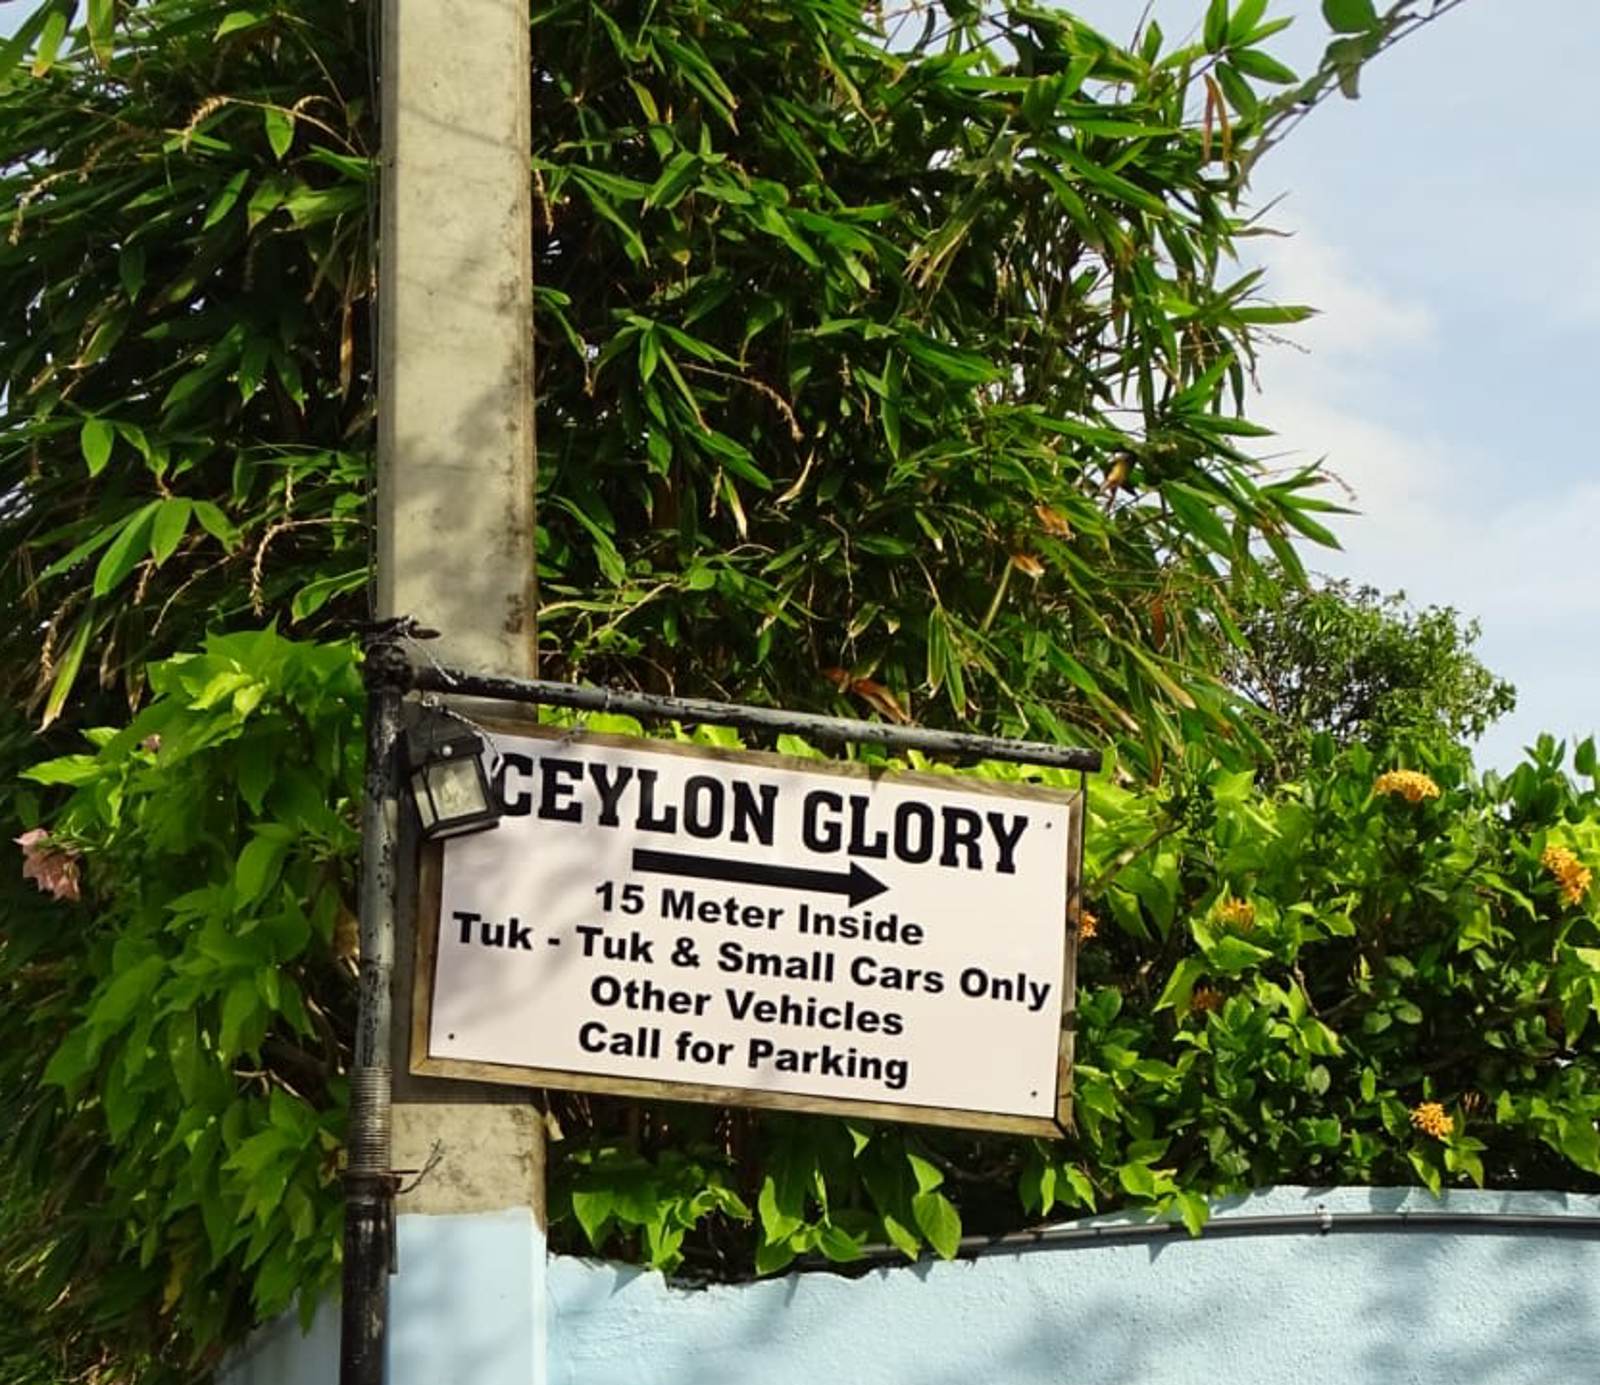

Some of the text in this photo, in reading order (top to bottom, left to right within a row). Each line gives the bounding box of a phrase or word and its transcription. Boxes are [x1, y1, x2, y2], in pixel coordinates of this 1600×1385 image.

[490, 751, 1029, 875] CEYLON GLORY
[595, 880, 924, 946] 15 Meter Inside
[452, 910, 532, 951] Tuk
[576, 924, 654, 964] Tuk
[670, 936, 700, 968] &
[717, 941, 834, 983] Small
[850, 956, 944, 994] Cars
[959, 967, 1051, 1012] Only
[590, 975, 903, 1036] Other Vehicles
[578, 1021, 908, 1090] Call for Parking
